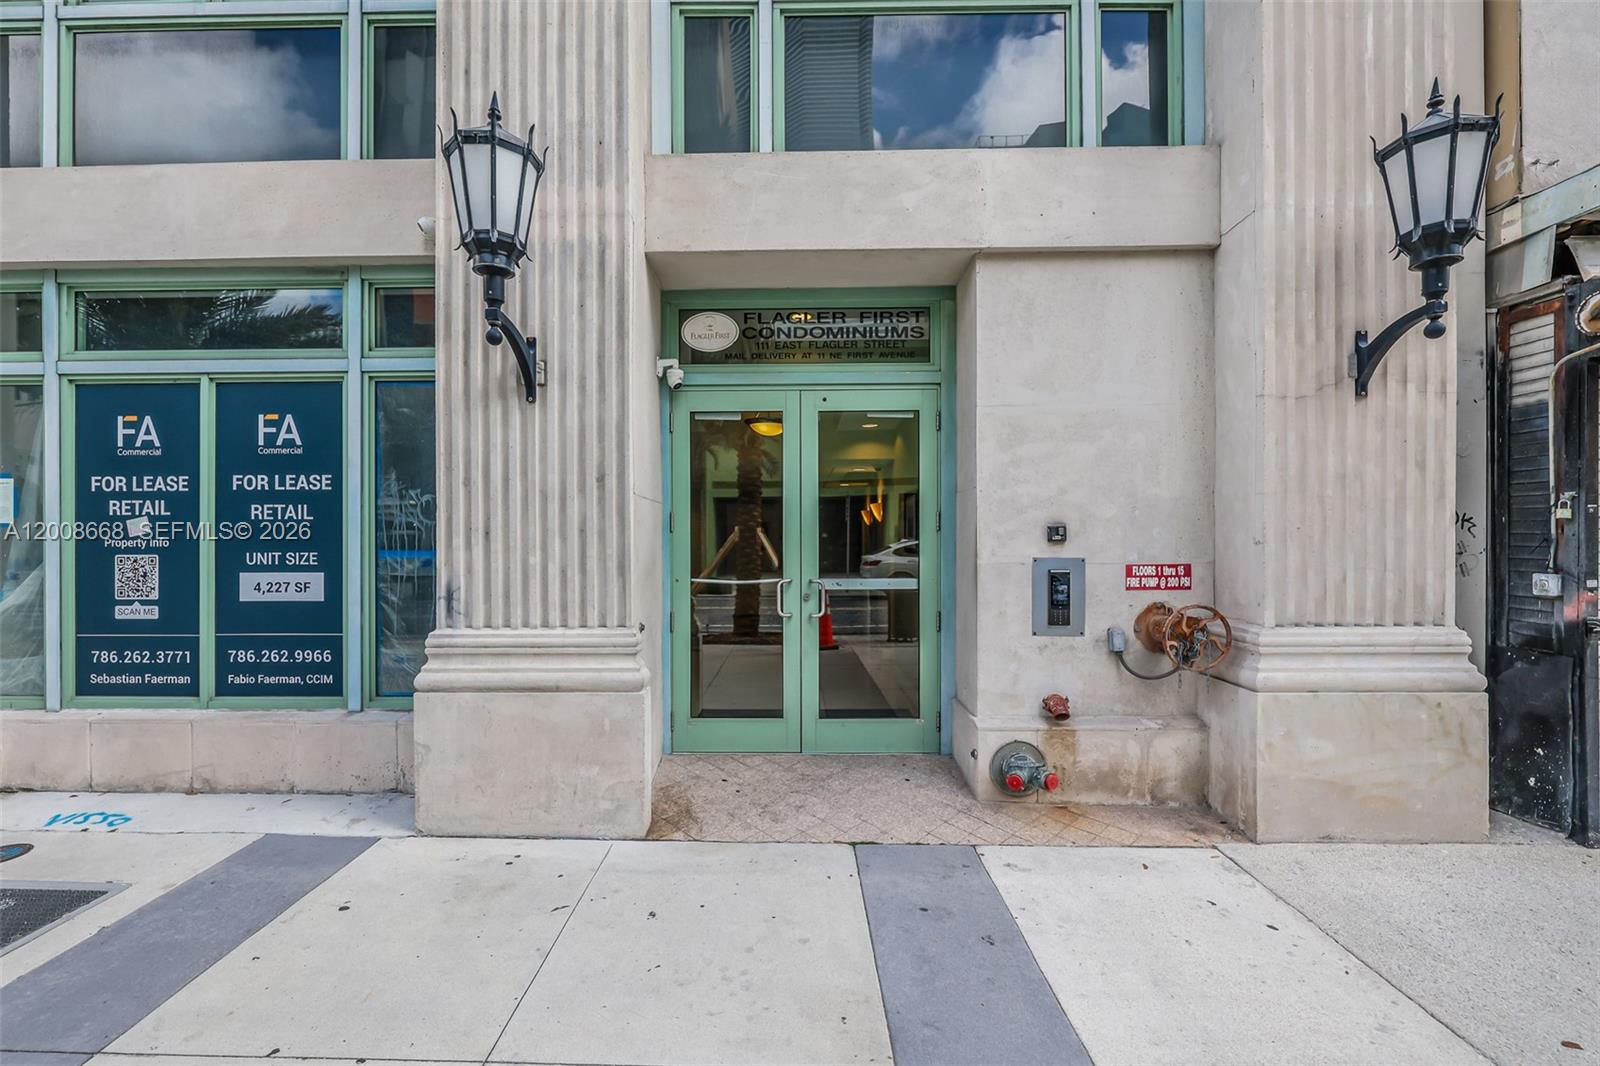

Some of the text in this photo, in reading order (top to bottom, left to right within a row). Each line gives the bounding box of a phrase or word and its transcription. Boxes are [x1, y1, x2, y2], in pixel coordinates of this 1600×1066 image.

[743, 310, 925, 325] FLAGLER FIRST
[742, 326, 925, 340] CONDOMINIUMS
[755, 339, 906, 351] 111 EAST FLAGLER STREET
[724, 352, 745, 360] MAIL
[751, 352, 796, 360] DELIVERY
[847, 351, 873, 359] FIRST
[879, 350, 916, 359] AVENUE
[117, 415, 161, 447] FA
[257, 413, 303, 446] FA
[117, 448, 162, 456] Commercial
[257, 446, 303, 455] Commercial
[90, 476, 189, 492] FOR LEASE
[232, 474, 332, 491] FOR LEASE
[108, 500, 171, 516] RETAIL
[250, 504, 314, 520] RETAIL
[104, 538, 146, 550] Property
[246, 552, 319, 566] UNIT SIZE
[1132, 565, 1185, 576] FLOORS 1 thru 15
[253, 581, 311, 595] 4,227 SF
[1126, 577, 1191, 589] FIRE PUMP @ 200 PSI
[117, 607, 156, 617] SCAN ME
[91, 650, 191, 664] 786.262.3771
[228, 649, 332, 663] 786.262.9966
[90, 673, 191, 685] Sebastian Faerman
[228, 673, 333, 686] Fabio Faerman, CCIM
